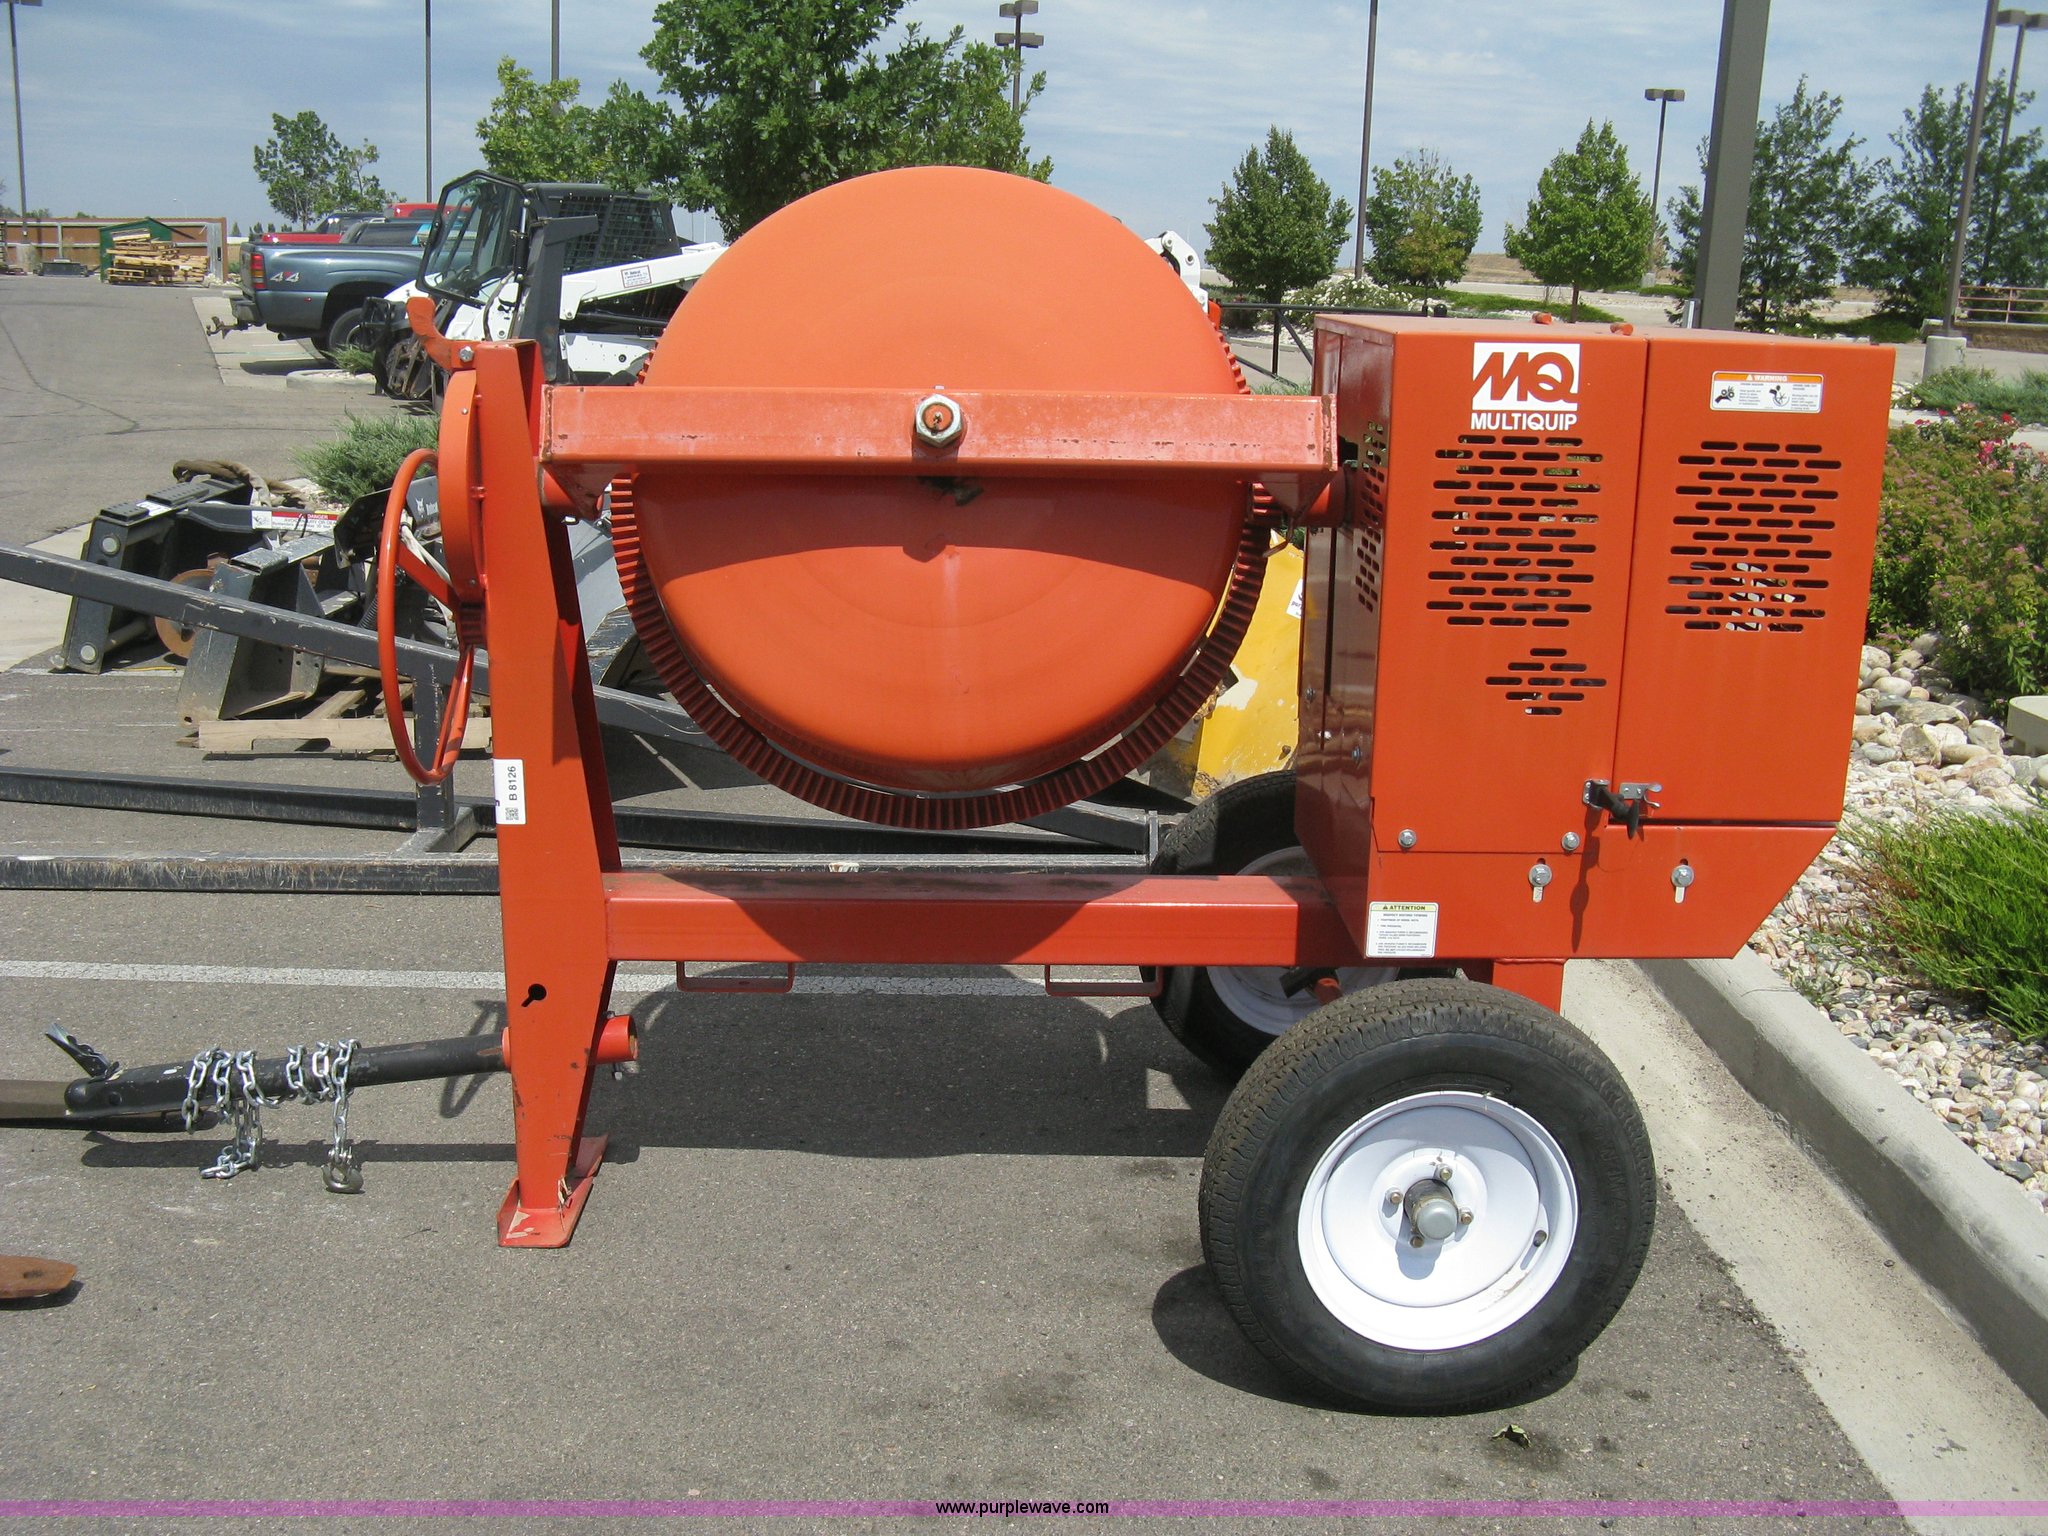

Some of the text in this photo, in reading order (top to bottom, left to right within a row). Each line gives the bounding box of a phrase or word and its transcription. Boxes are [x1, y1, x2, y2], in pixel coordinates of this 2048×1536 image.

[1472, 351, 1578, 403] MQ
[1471, 412, 1577, 431] MULTIQUIP
[507, 765, 518, 801] B 8126
